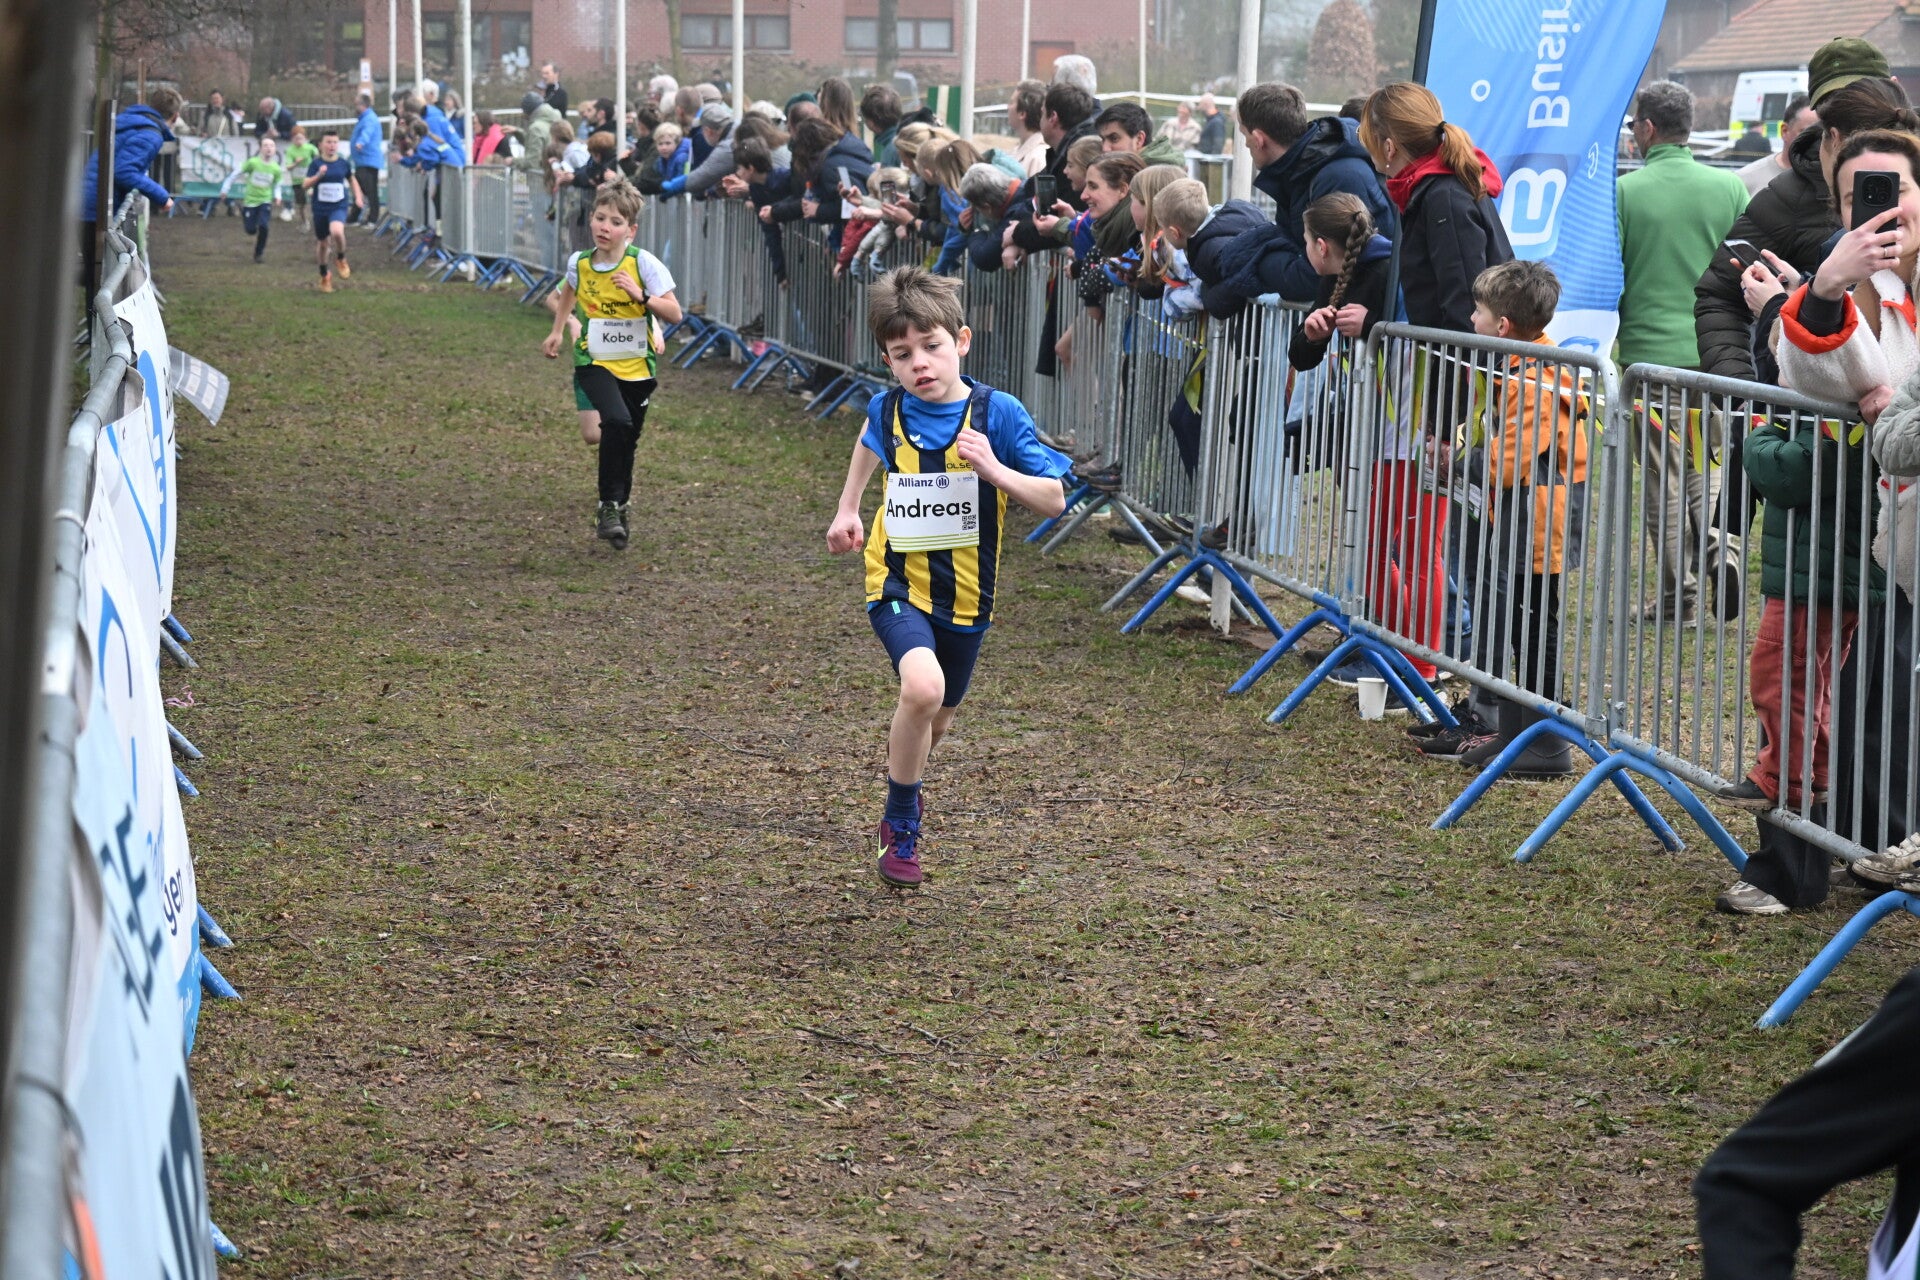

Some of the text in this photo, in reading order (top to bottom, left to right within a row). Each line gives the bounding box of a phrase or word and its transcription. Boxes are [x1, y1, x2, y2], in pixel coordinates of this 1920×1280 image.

[602, 332, 634, 343] Kobe
[898, 477, 933, 487] Allianz
[886, 498, 972, 518] Andreas
